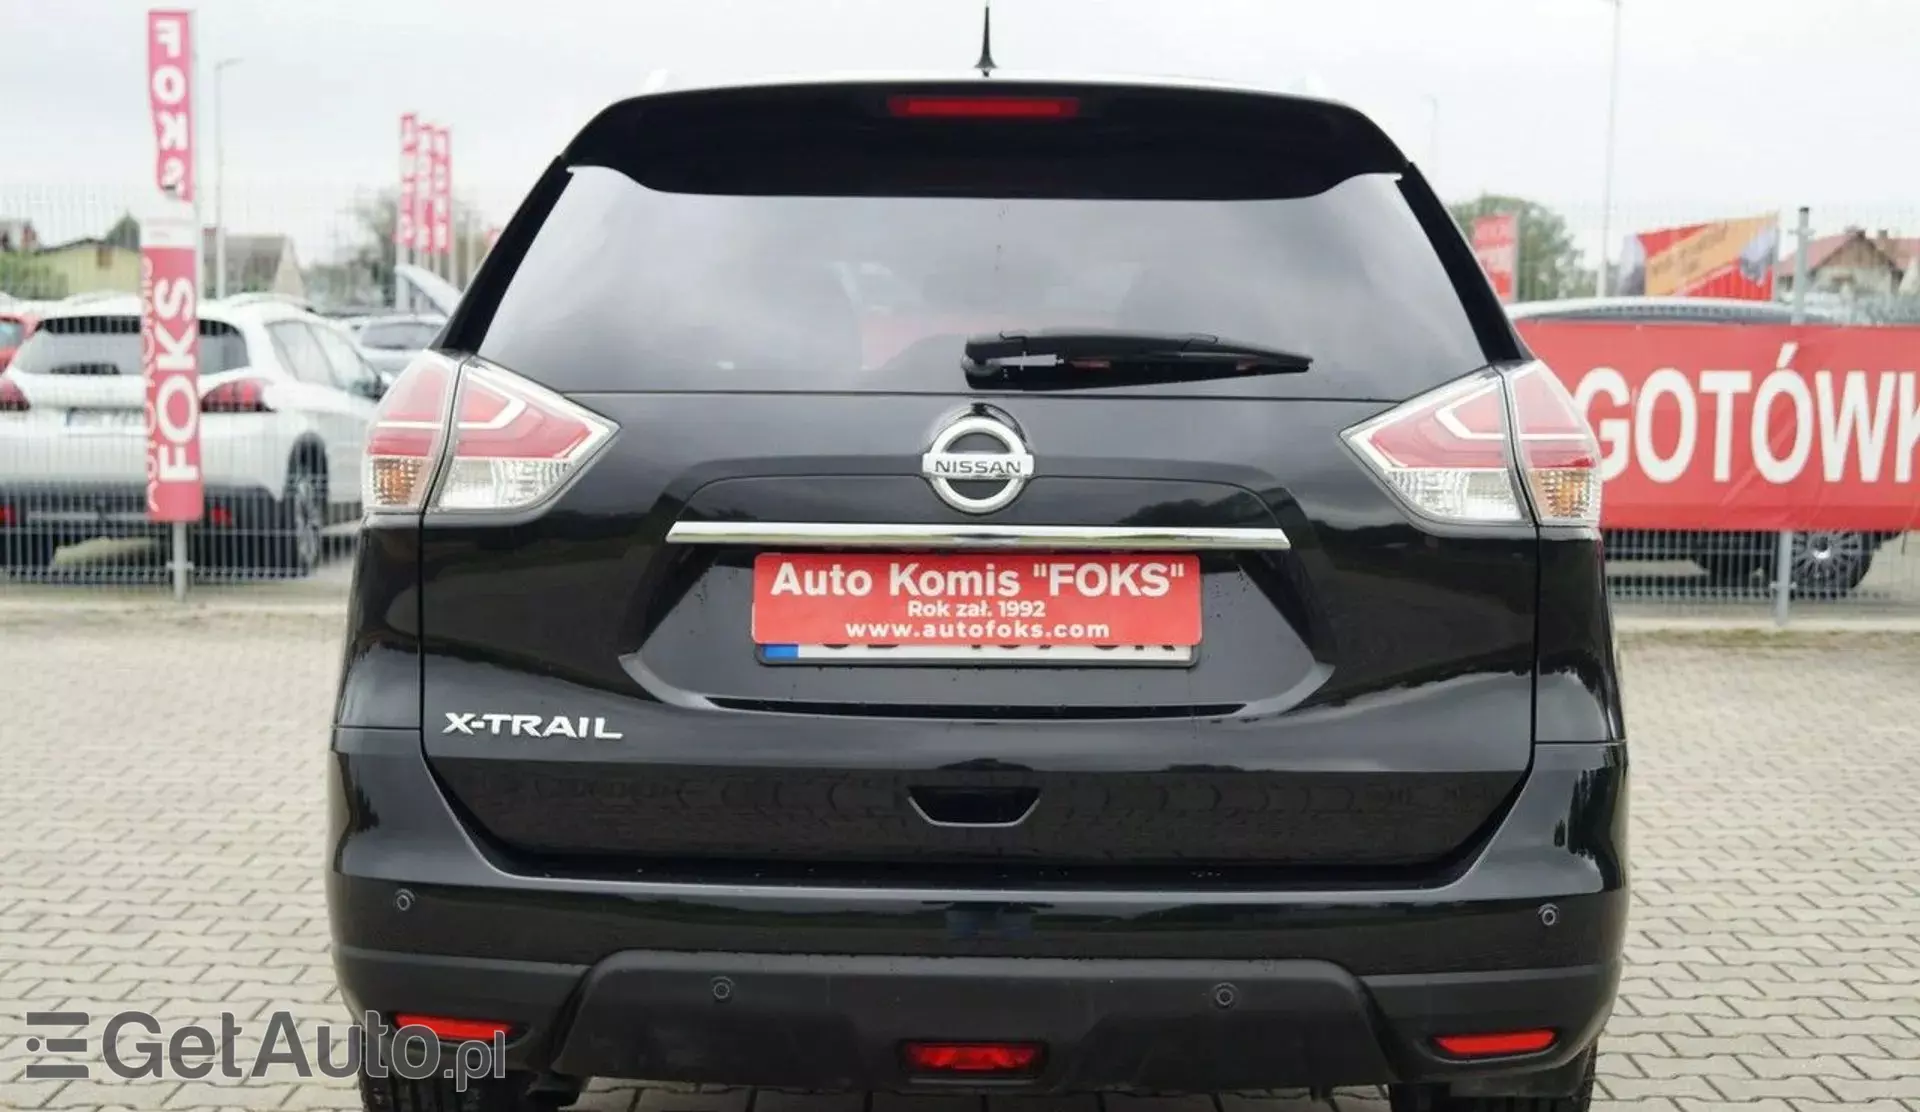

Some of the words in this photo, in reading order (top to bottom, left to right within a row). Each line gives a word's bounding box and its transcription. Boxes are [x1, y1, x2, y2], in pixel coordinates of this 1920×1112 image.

[153, 277, 198, 481] FOKS
[935, 460, 1021, 473] NISSAN
[770, 562, 873, 597] Auto
[888, 562, 1021, 597] Komis
[1033, 562, 1185, 597] "FOKS"
[907, 601, 949, 617] Rok
[956, 601, 992, 618] zał.
[998, 601, 1046, 617] 1992
[845, 620, 1110, 639] www.autofoks.com
[442, 712, 624, 740] X-TRAIL
